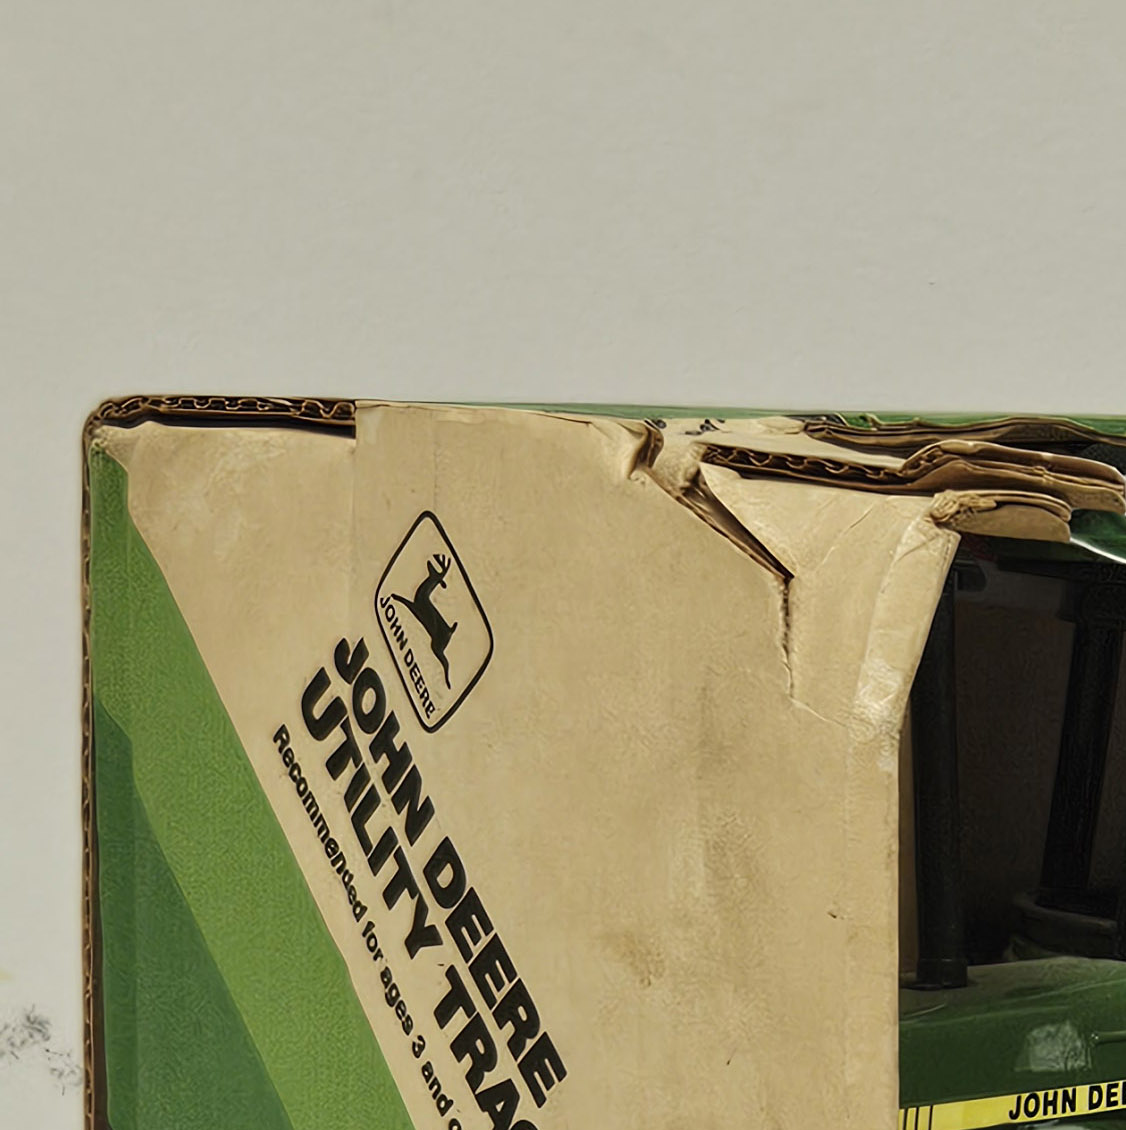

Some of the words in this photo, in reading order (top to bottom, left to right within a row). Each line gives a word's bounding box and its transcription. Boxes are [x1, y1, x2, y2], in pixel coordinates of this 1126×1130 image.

[380, 597, 408, 651] JOHN
[404, 648, 436, 719] DEERE
[272, 723, 368, 923] Recommended
[361, 920, 384, 962] for
[380, 966, 414, 1036] ages
[412, 1035, 426, 1058] 3
[421, 1061, 454, 1117] and
[301, 667, 443, 960] UTILITY
[334, 637, 435, 846] JOHN
[423, 836, 567, 1108] DEERE
[1008, 1087, 1077, 1121] JOHN
